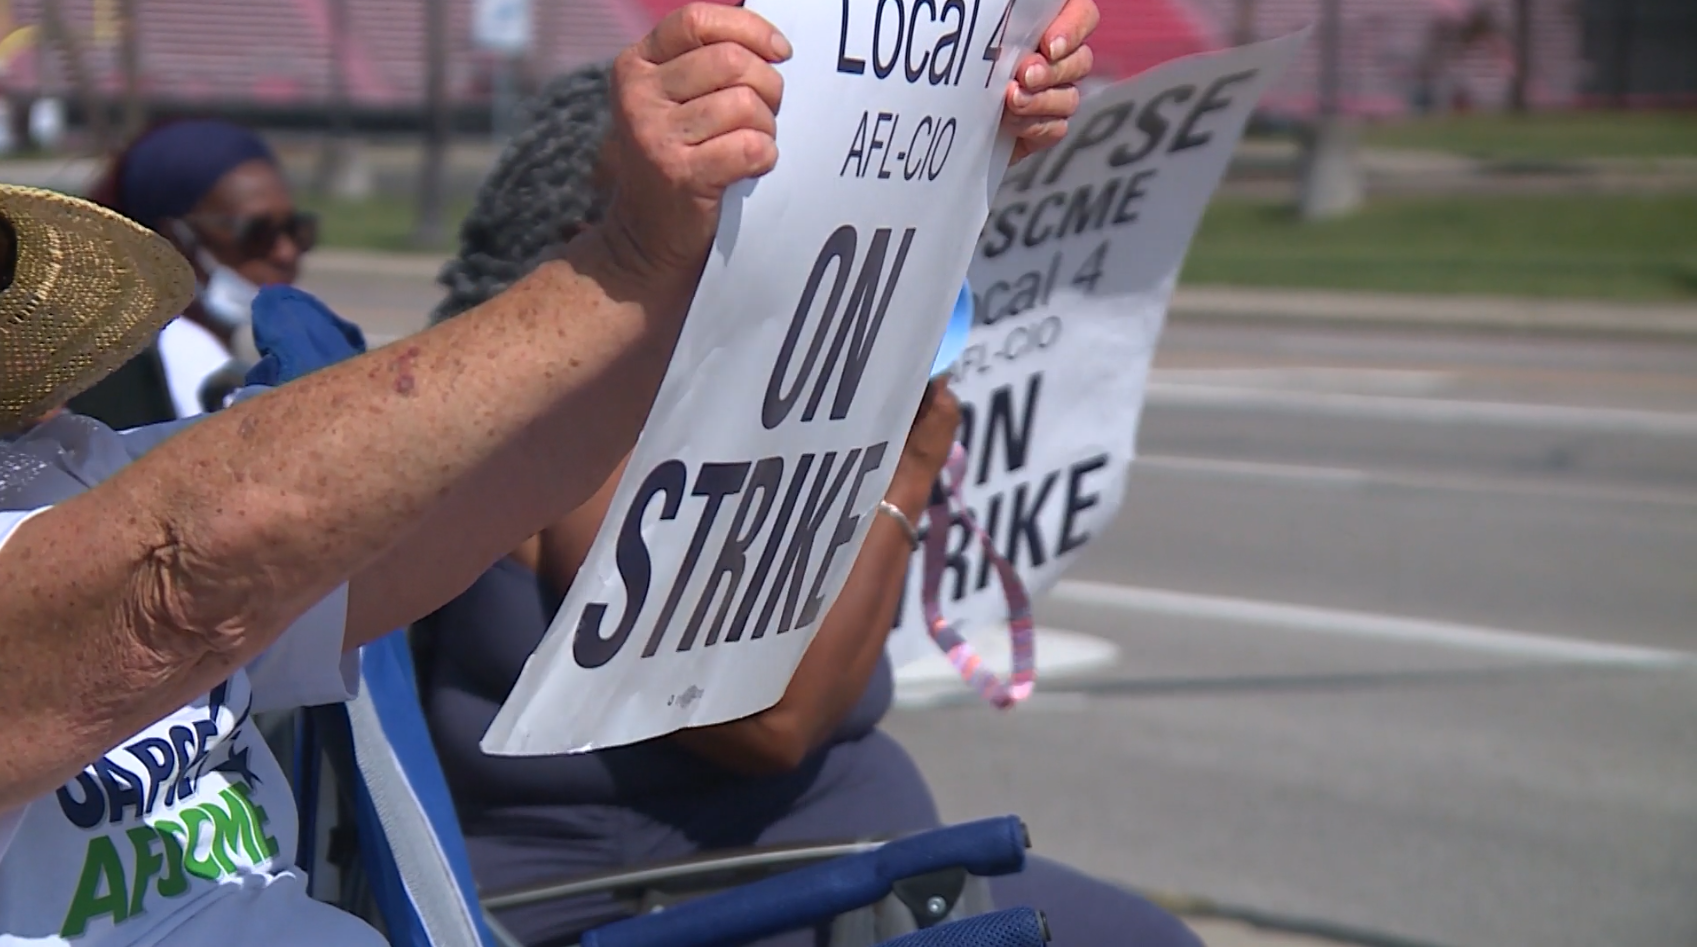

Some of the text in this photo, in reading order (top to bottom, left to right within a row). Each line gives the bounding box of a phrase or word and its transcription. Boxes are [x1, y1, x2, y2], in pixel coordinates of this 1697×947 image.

[837, 0, 1016, 89] Local 4
[839, 111, 957, 182] AFL-CIO
[980, 168, 1158, 258] SCME
[1072, 240, 1109, 297] 4
[761, 225, 916, 430] ON
[572, 441, 888, 669] STRIKE
